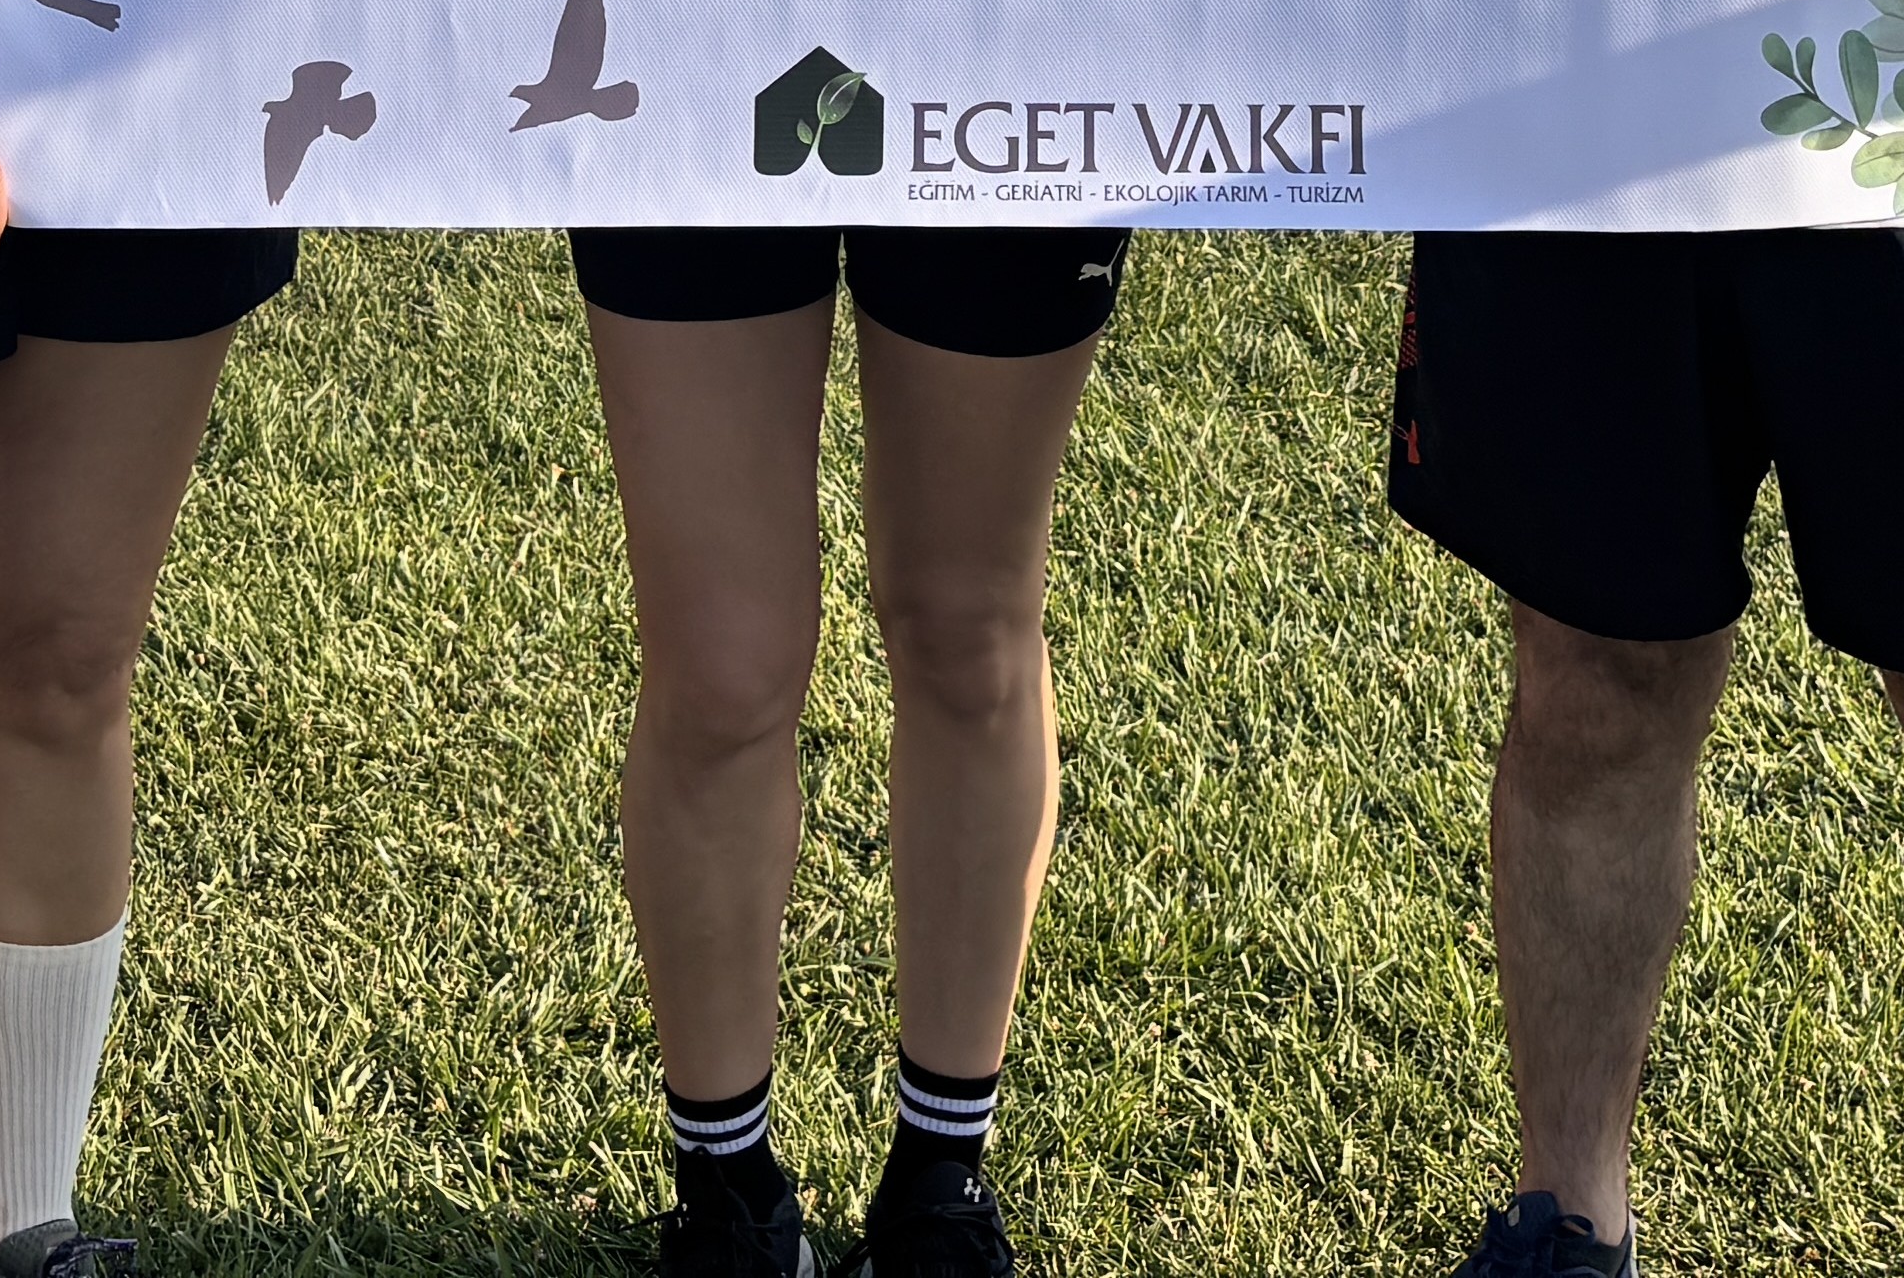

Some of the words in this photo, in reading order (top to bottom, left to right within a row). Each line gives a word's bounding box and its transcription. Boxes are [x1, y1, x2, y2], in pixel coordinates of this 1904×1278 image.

[910, 102, 1115, 174] EGET
[1131, 103, 1366, 175] VAKFI
[907, 180, 976, 202] EĞİTİM
[995, 181, 1083, 202] GERİATRİ
[1104, 183, 1199, 207] EKOLOJİK
[1203, 185, 1268, 204] TARIM
[1288, 182, 1364, 204] TURİZM
